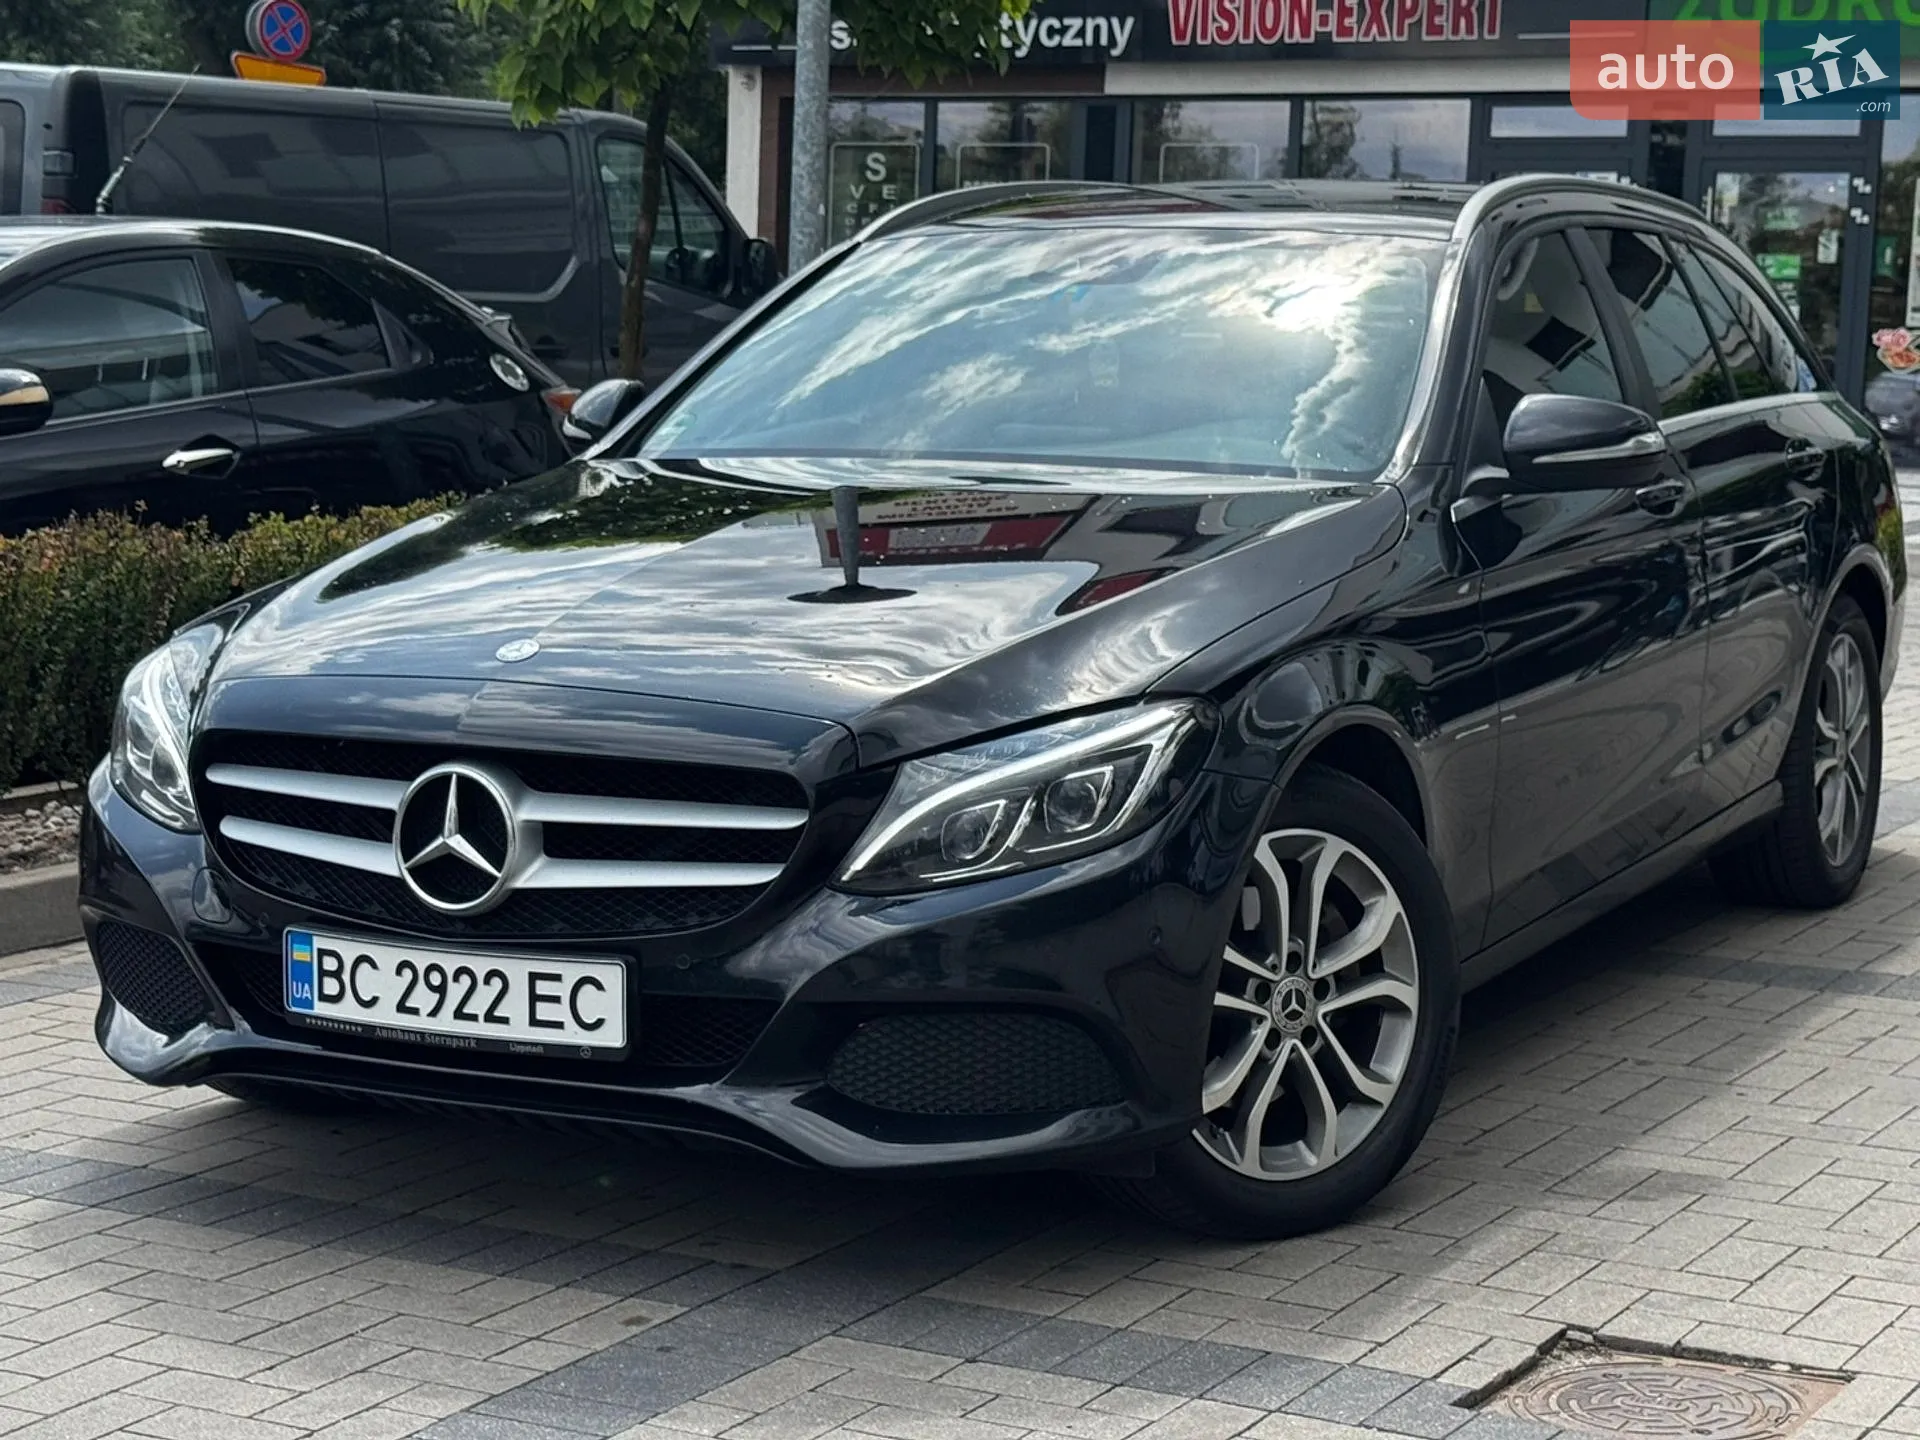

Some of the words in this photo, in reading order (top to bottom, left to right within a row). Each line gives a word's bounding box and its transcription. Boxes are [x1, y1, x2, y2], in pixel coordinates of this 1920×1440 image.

[1168, 0, 1501, 45] VISION-EXPERT
[865, 152, 887, 182] S
[293, 981, 311, 1001] UA
[317, 947, 380, 1009] BC
[395, 959, 510, 1025] 2922
[528, 971, 606, 1031] EC
[374, 1027, 421, 1043] Autohaus
[425, 1033, 477, 1049] Sternpark
